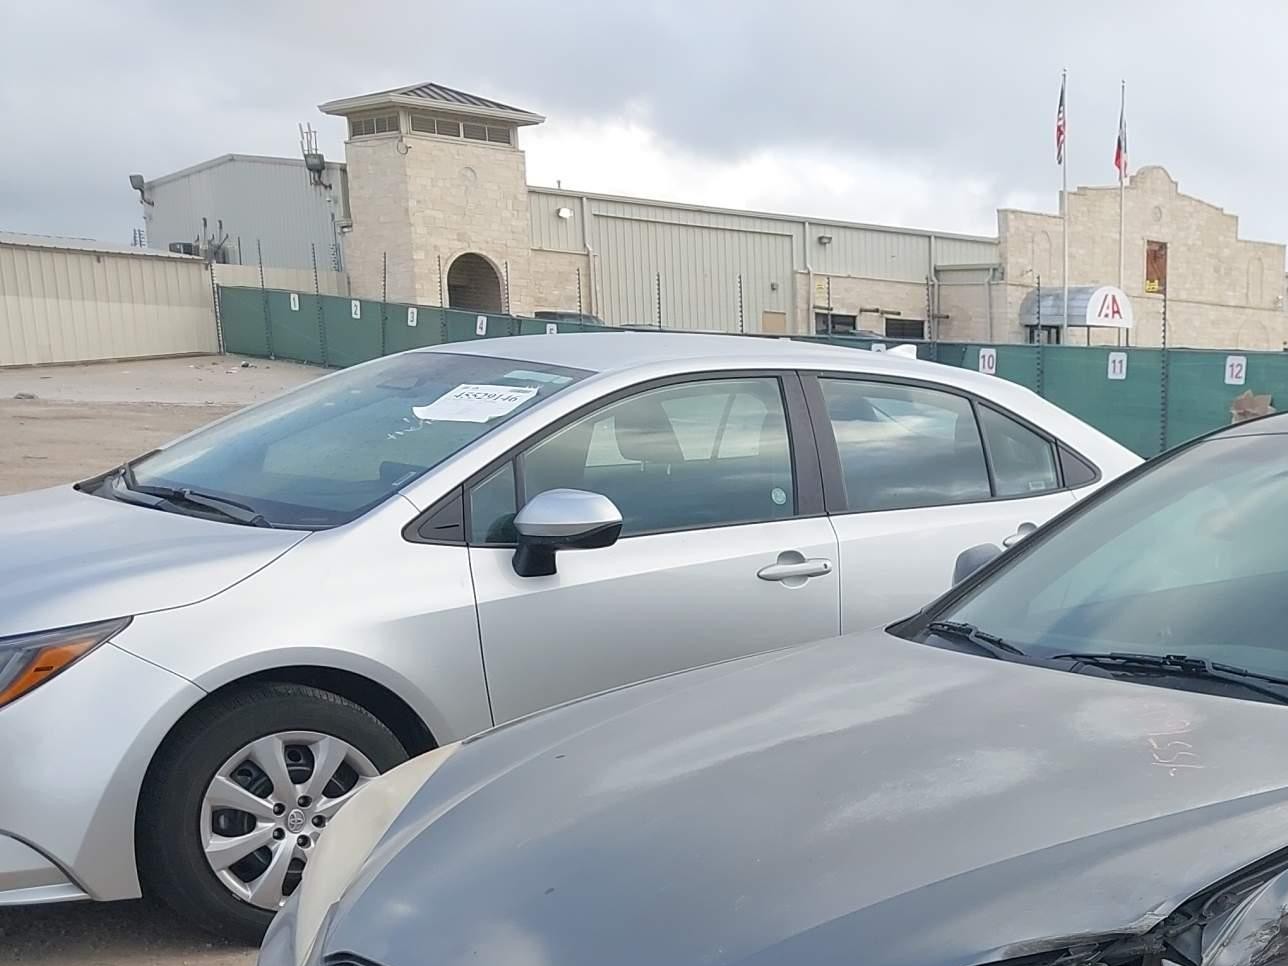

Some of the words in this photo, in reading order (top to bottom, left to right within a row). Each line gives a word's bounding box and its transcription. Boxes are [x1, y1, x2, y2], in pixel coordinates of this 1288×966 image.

[981, 354, 995, 370] 10
[1111, 359, 1123, 374] 11
[1228, 362, 1244, 380] 12
